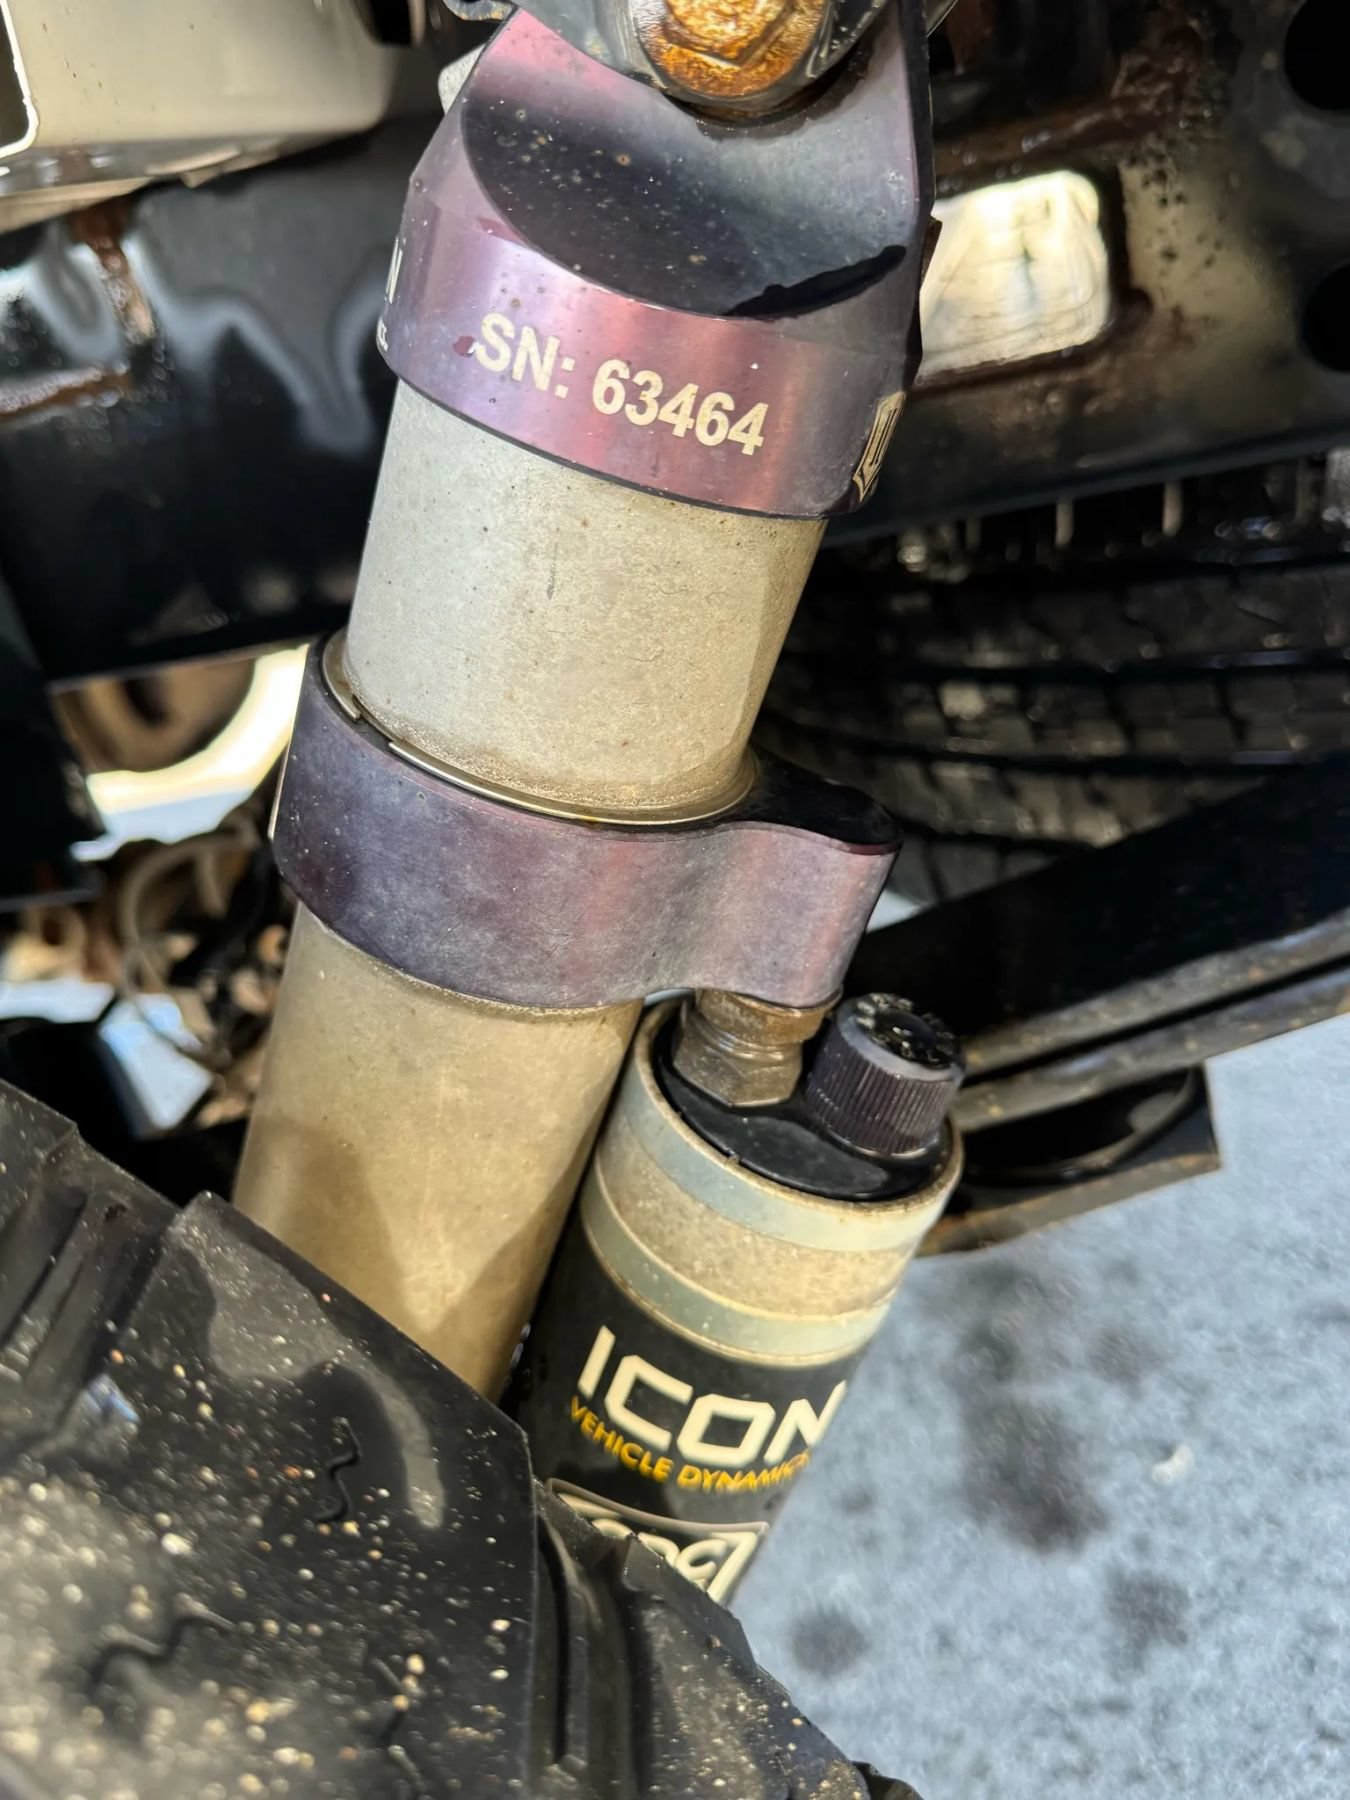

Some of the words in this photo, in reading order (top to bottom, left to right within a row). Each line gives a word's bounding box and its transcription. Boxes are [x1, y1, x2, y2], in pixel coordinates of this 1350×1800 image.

[475, 312, 576, 397] SN:
[592, 358, 769, 456] 63464
[570, 1395, 674, 1482] VEHICLE
[577, 1324, 847, 1467] ICON
